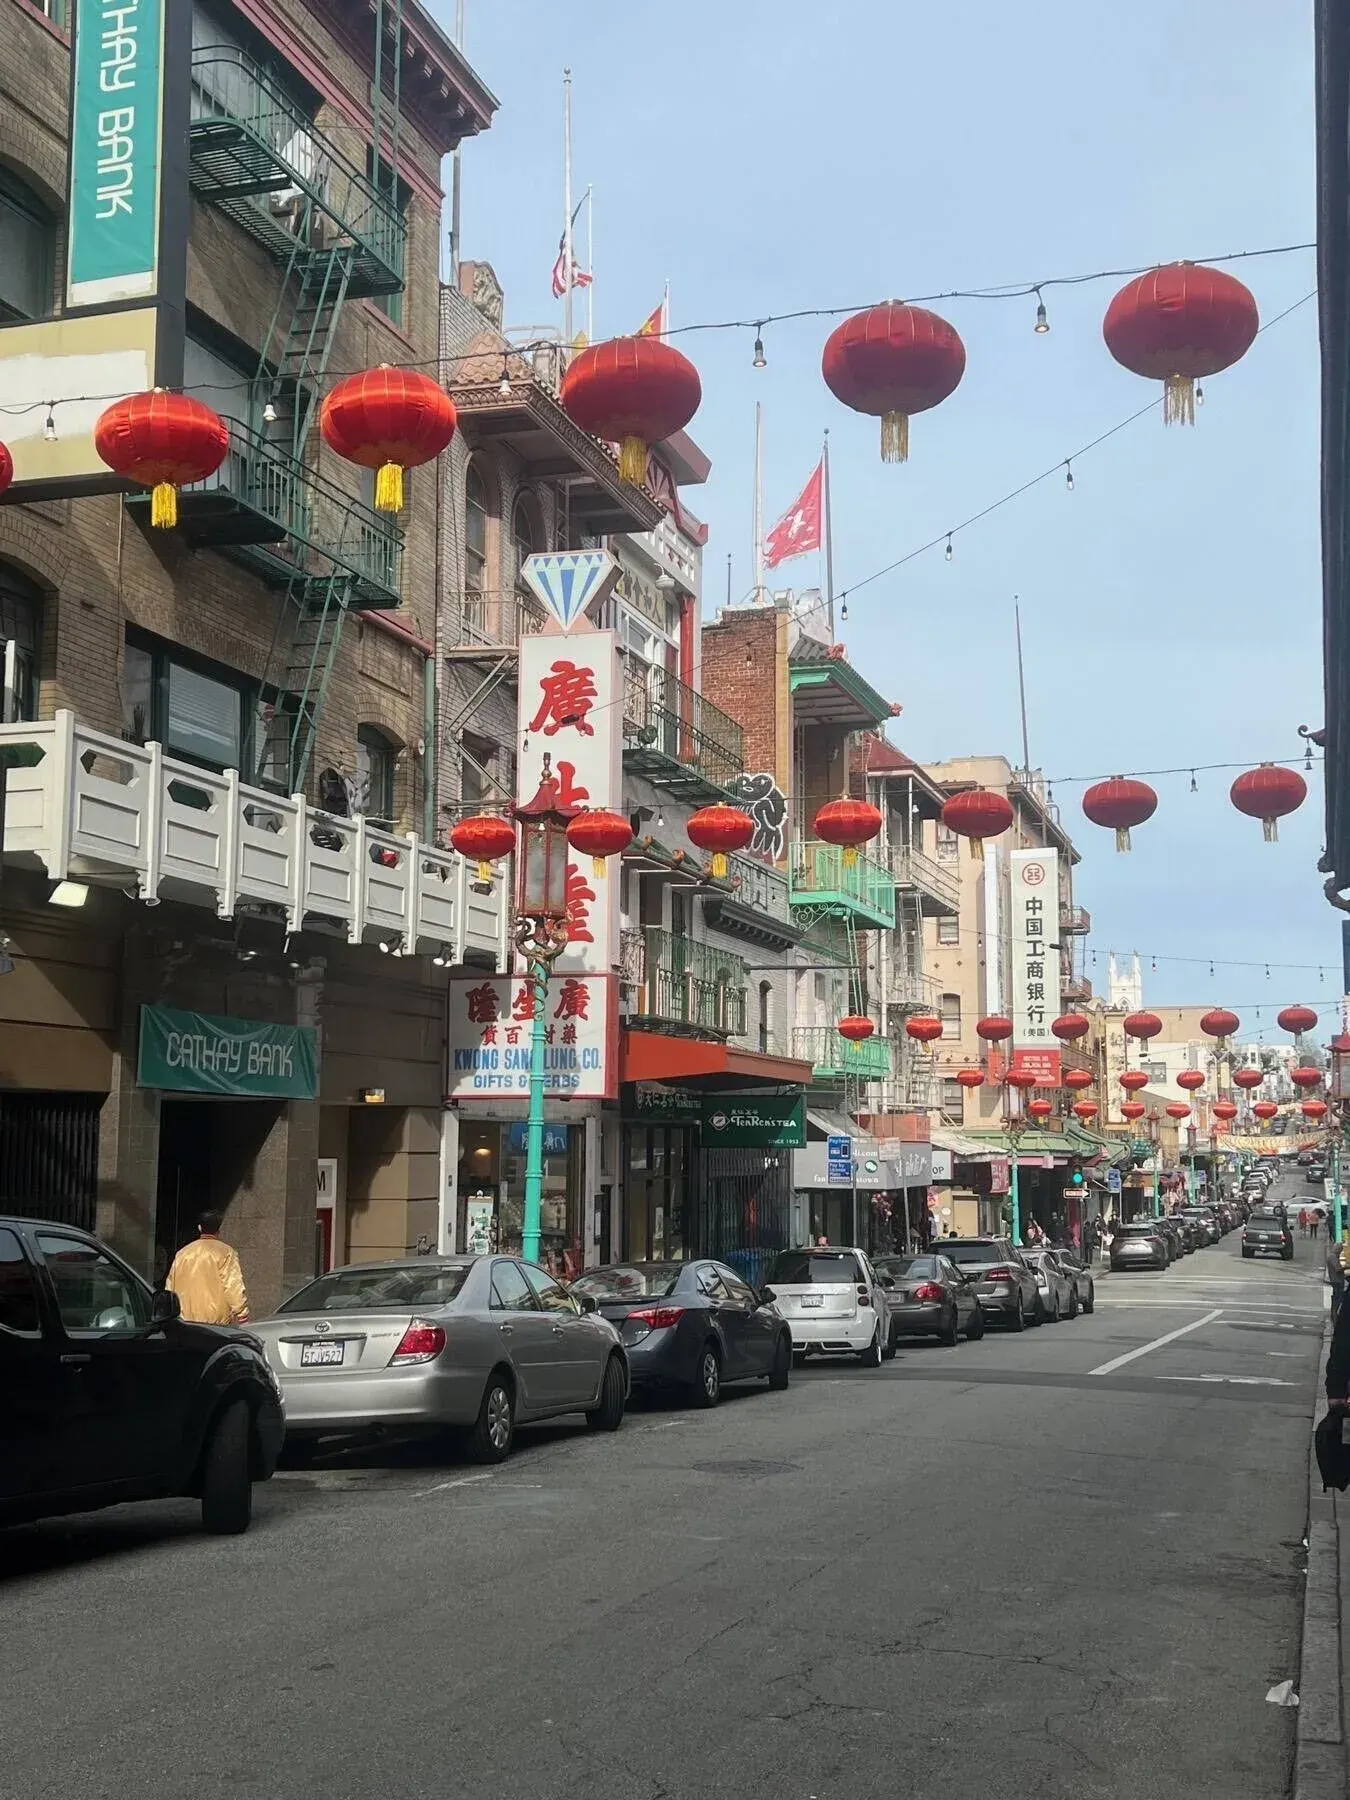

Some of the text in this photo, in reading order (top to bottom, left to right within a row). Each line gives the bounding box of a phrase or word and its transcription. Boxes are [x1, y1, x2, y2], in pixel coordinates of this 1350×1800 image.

[96, 106, 135, 219] BANK
[1025, 896, 1046, 1025] 中国工商银行
[166, 1032, 294, 1078] CATHAY BANK
[454, 1048, 602, 1070] KWONG SAN LUNG CO.
[473, 1074, 512, 1088] GIFTS
[542, 1074, 580, 1088] ERBS
[776, 1119, 797, 1127] TEA
